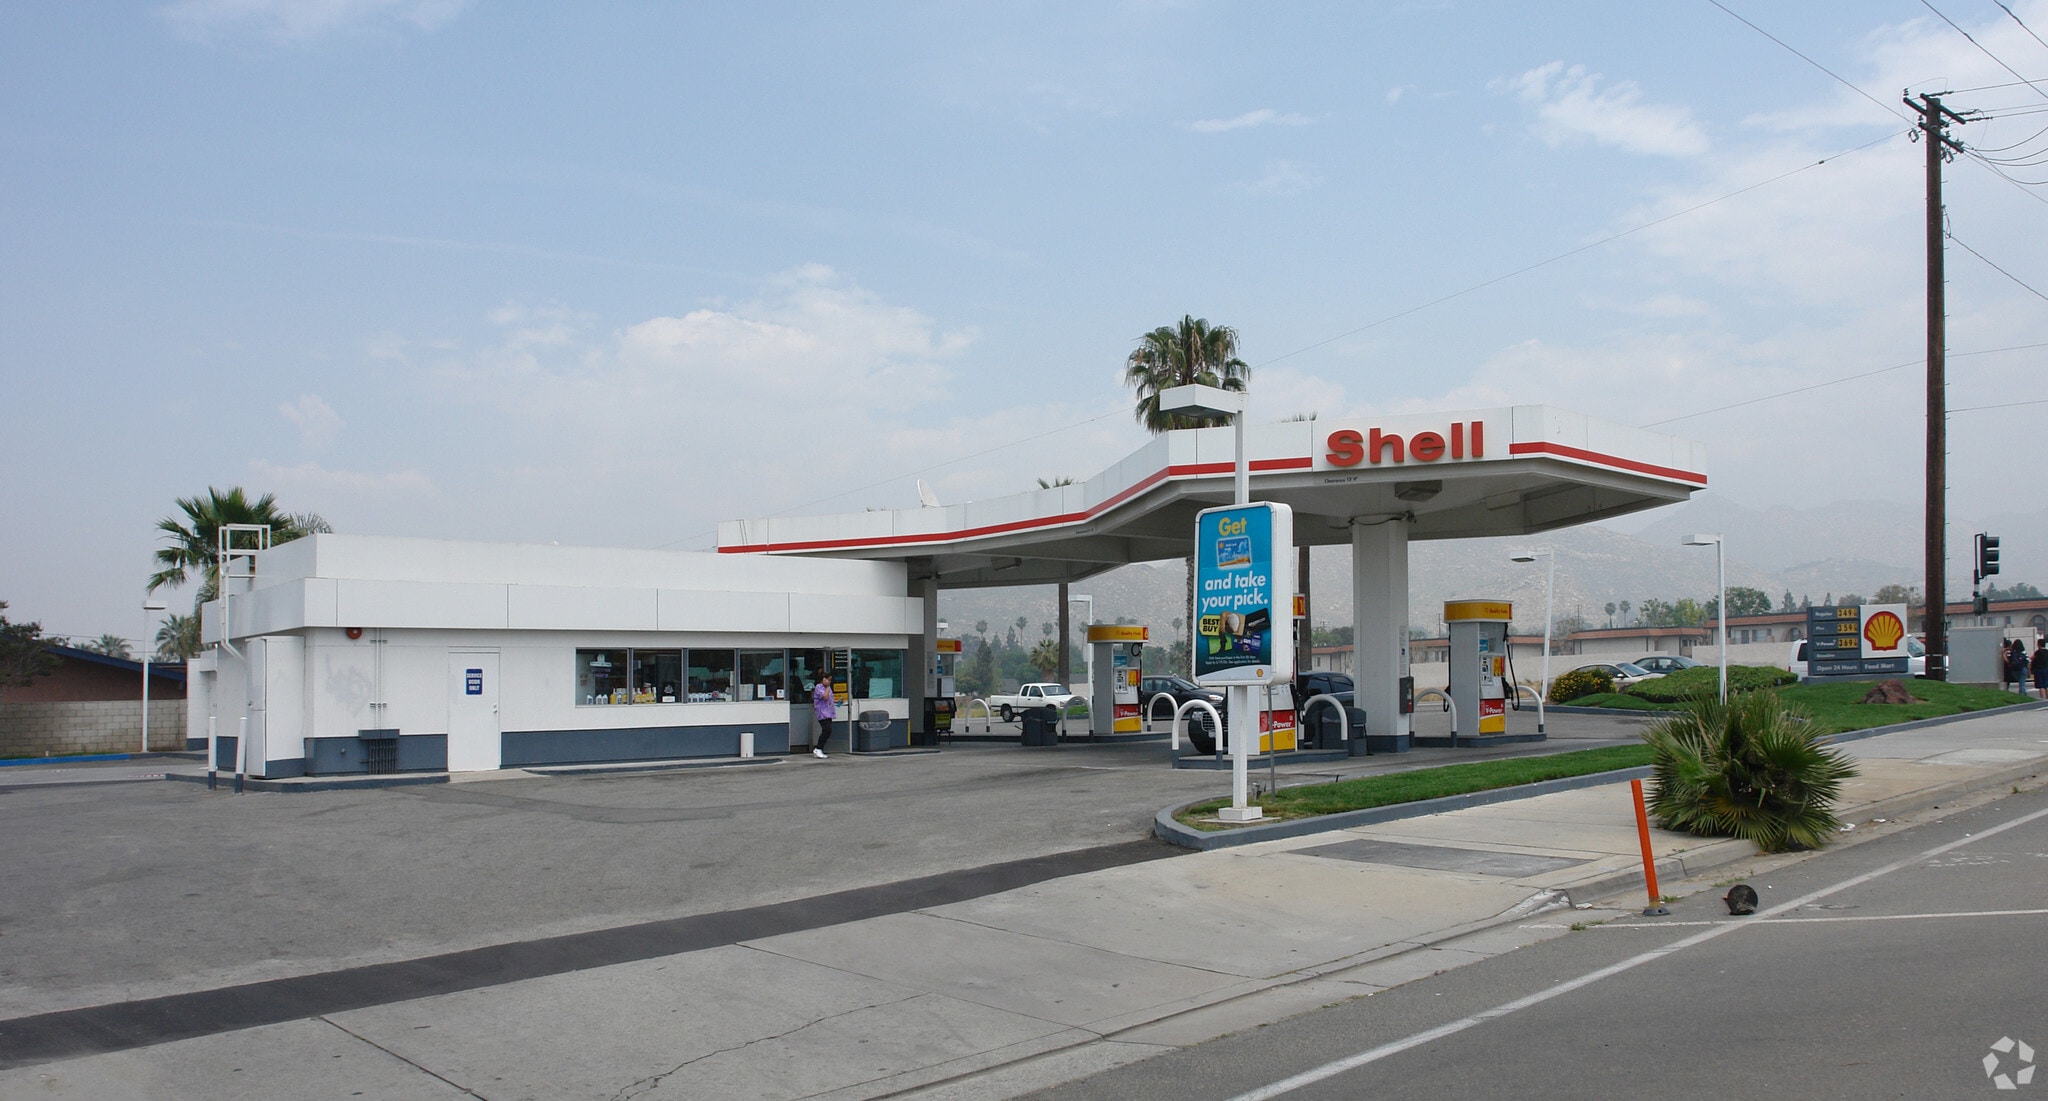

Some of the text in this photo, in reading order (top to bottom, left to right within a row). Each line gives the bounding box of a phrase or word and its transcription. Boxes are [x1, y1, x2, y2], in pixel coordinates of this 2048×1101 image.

[1325, 421, 1483, 468] Shell
[1218, 516, 1248, 537] Get
[1204, 570, 1267, 591] and take
[1201, 587, 1269, 613] your pick.
